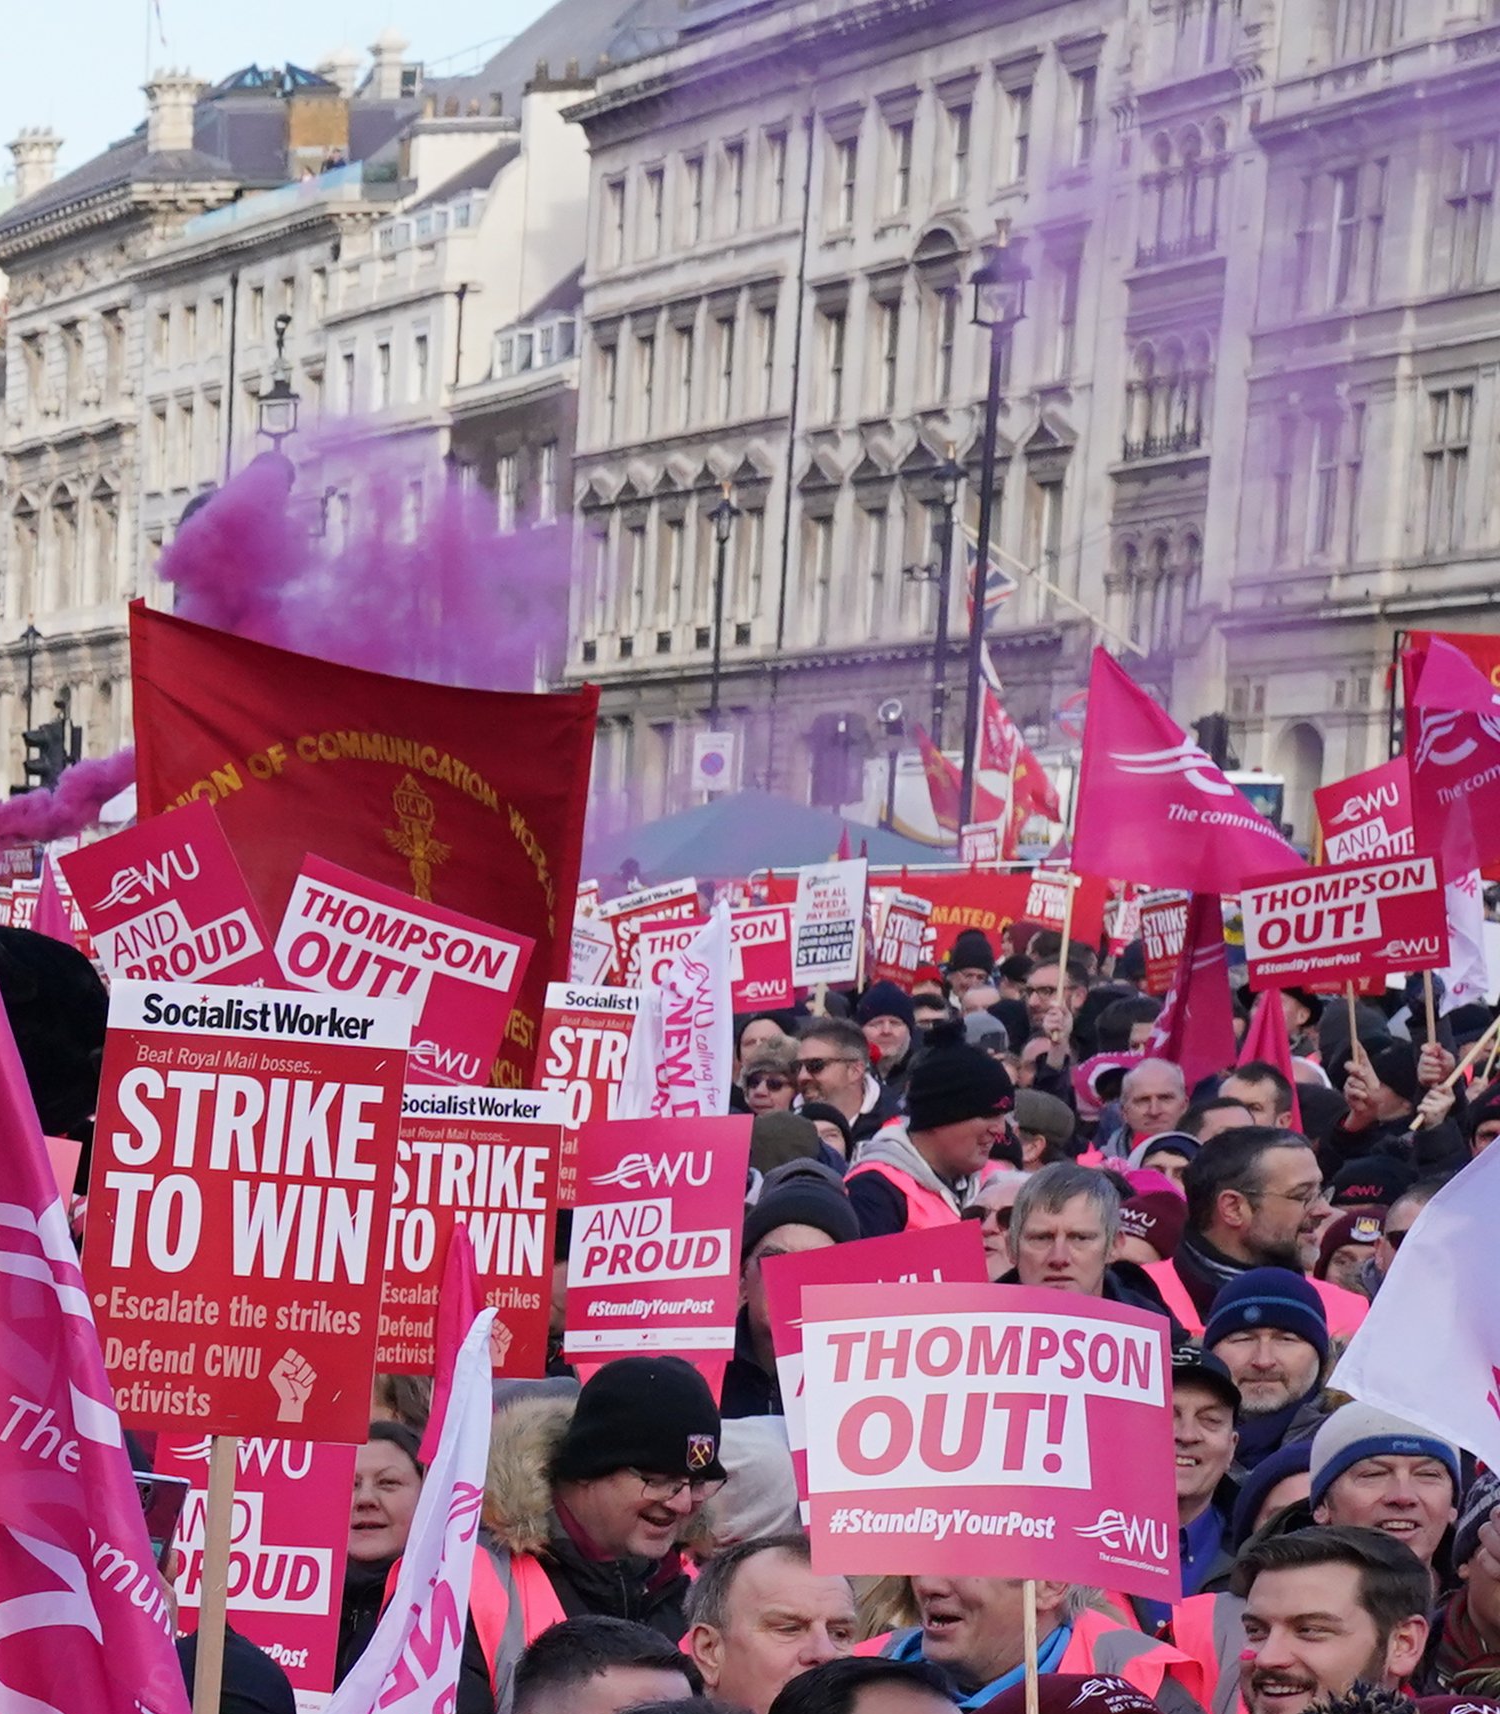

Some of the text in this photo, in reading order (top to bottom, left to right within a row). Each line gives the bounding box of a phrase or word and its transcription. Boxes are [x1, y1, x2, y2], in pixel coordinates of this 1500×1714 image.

[250, 742, 290, 779] OF
[295, 731, 501, 811] COMMUNICATION
[812, 899, 847, 910] NEED A
[814, 887, 847, 898] WE ALL
[1252, 865, 1426, 915] THOMPSON
[111, 908, 180, 961] AND
[298, 885, 509, 981] THOMPSON
[799, 920, 854, 938] BUILD FOR A
[806, 910, 824, 921] PAY
[1258, 905, 1365, 949] OUT!
[797, 945, 852, 966] STRIKE
[143, 992, 374, 1040] Socialist Worker
[136, 1044, 322, 1078] Beat Royal Mail bosses...
[113, 1065, 384, 1181] STRIKE
[620, 1150, 713, 1189] CWU
[1346, 1185, 1383, 1198] CWU
[104, 1171, 374, 1286] TO WIN
[584, 1235, 721, 1276] PROUD
[110, 1286, 361, 1335] Escalate the strikes
[104, 1338, 262, 1380] Defend CWU
[826, 1324, 1153, 1392] THOMPSON
[836, 1393, 1067, 1478] OUT!
[829, 1507, 1057, 1541] #StandByYourPost
[1098, 1509, 1168, 1559] CWU
